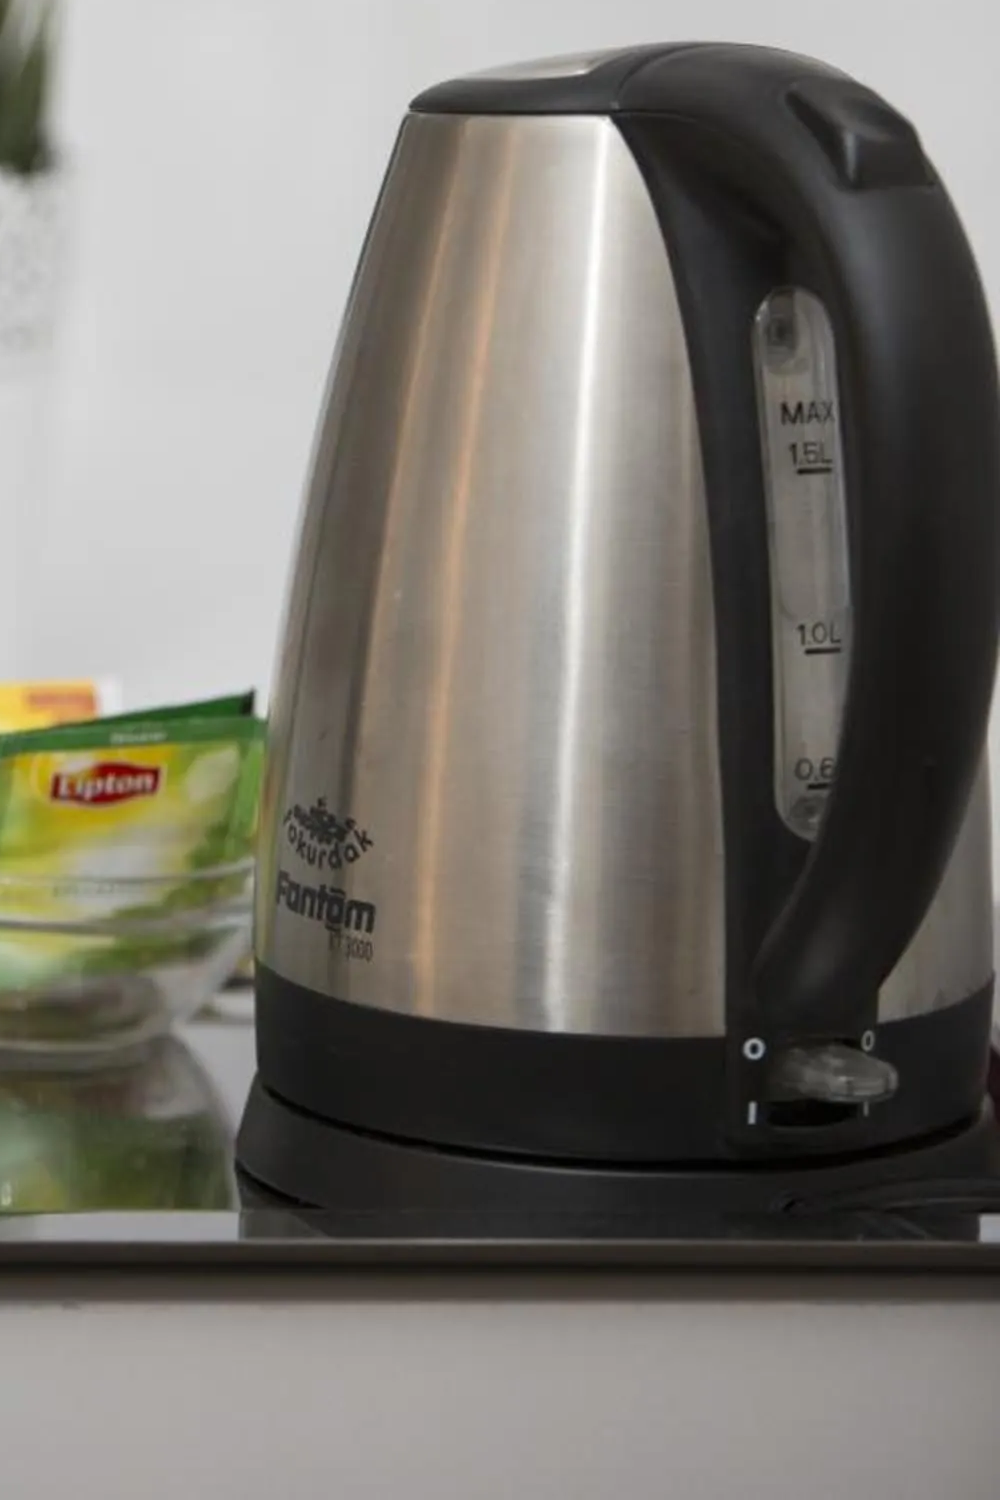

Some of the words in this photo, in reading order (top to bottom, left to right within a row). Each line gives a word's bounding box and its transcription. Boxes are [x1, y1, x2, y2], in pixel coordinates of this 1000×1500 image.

[780, 400, 835, 425] MAX
[796, 620, 841, 645] 1.0L
[794, 757, 835, 781] 0.6
[57, 770, 155, 801] Lipton
